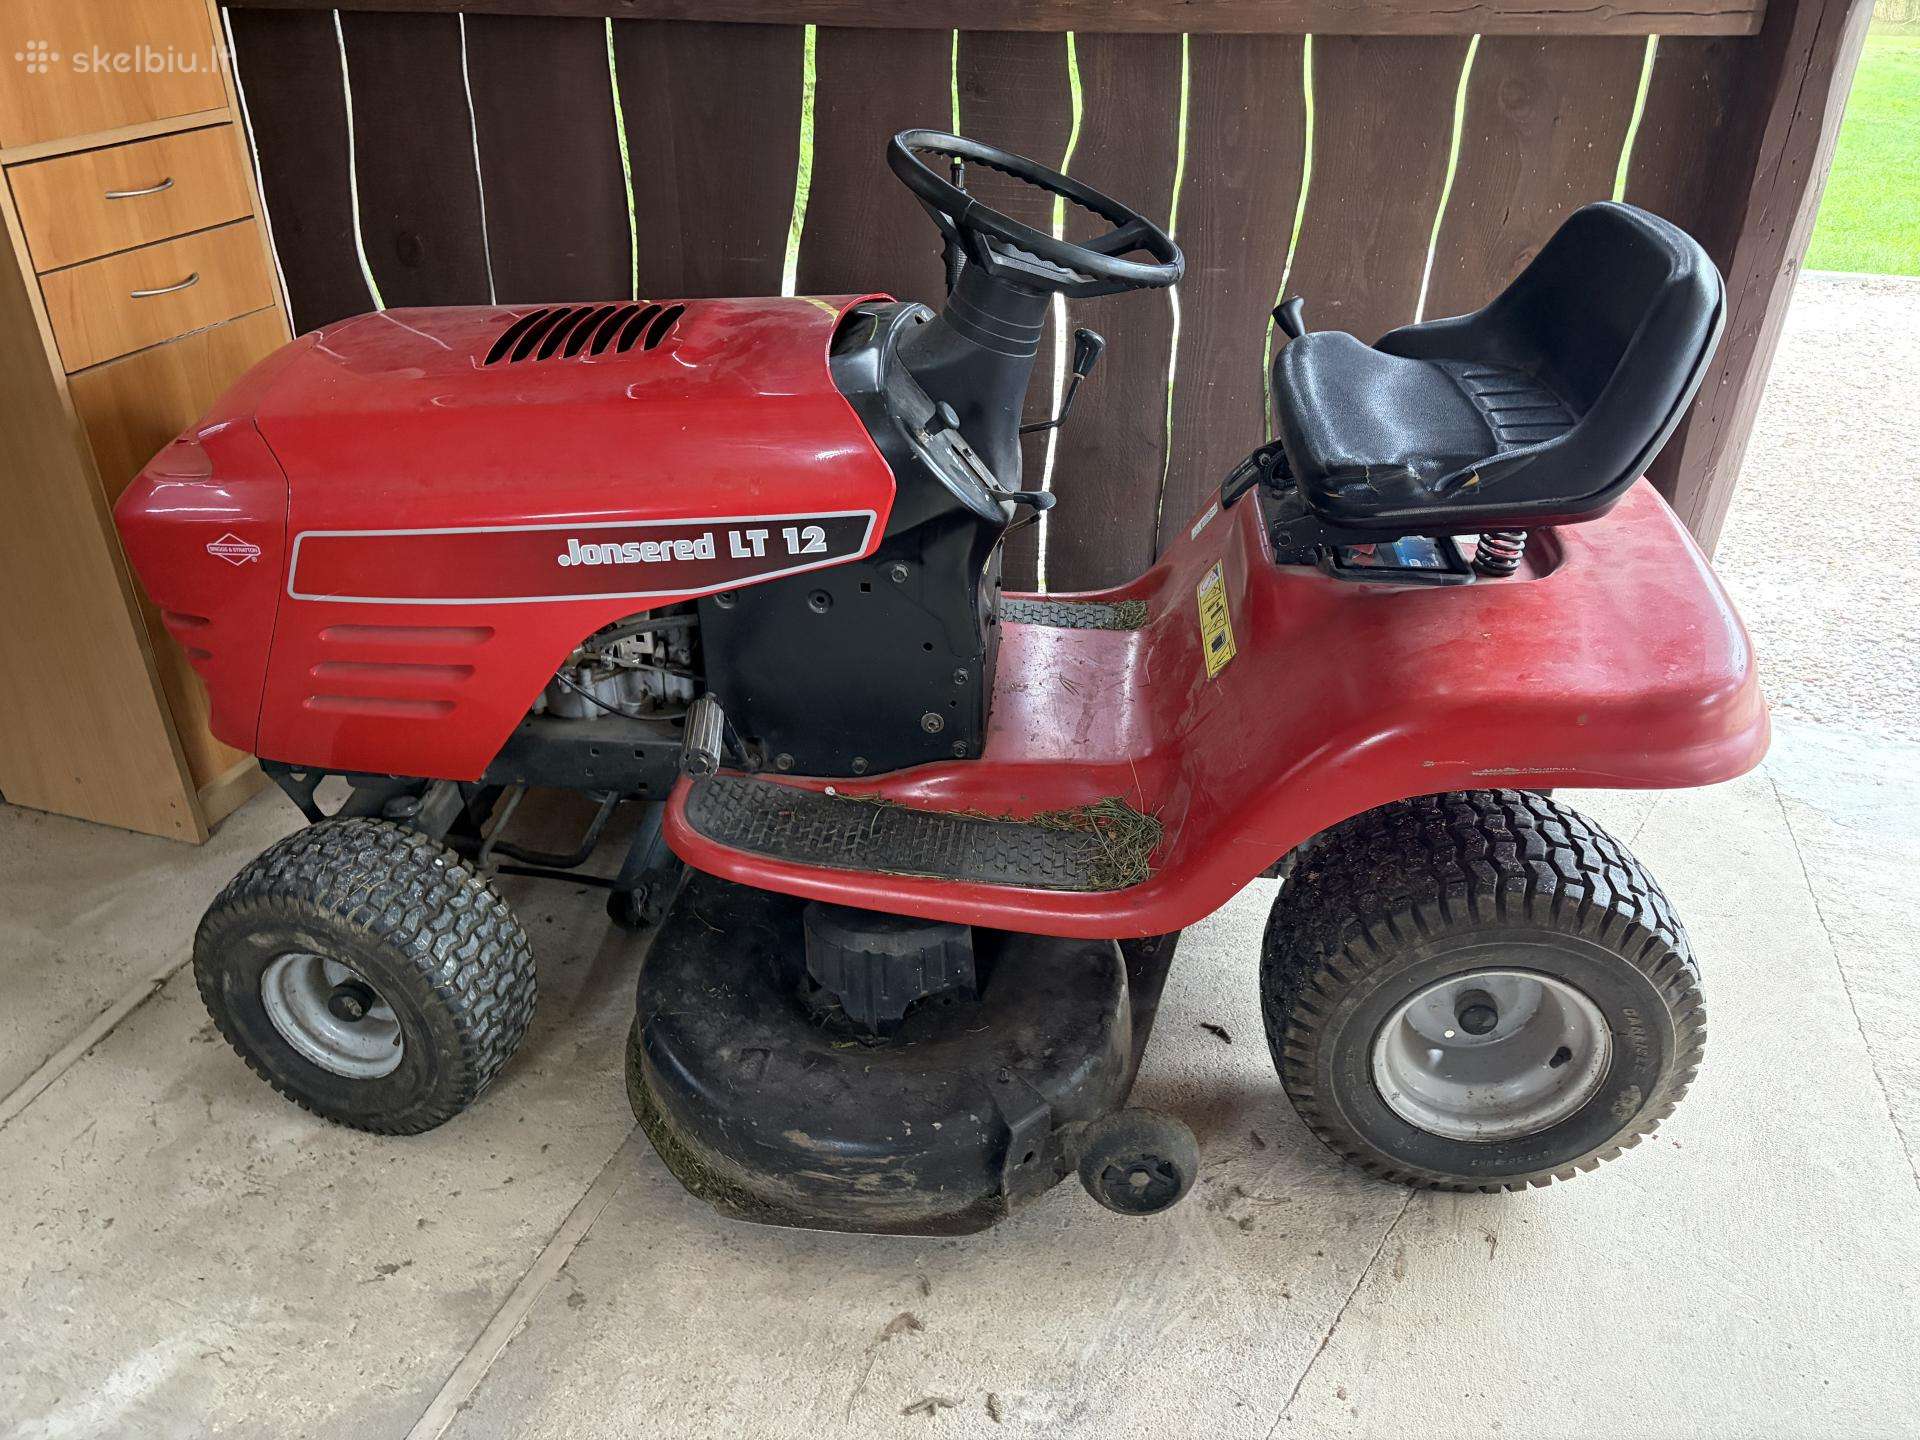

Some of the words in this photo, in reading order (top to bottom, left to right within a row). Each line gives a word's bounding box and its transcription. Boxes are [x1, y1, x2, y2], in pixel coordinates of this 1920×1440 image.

[558, 533, 716, 567] Jonsered
[728, 529, 768, 559] LT
[782, 526, 828, 554] 12
